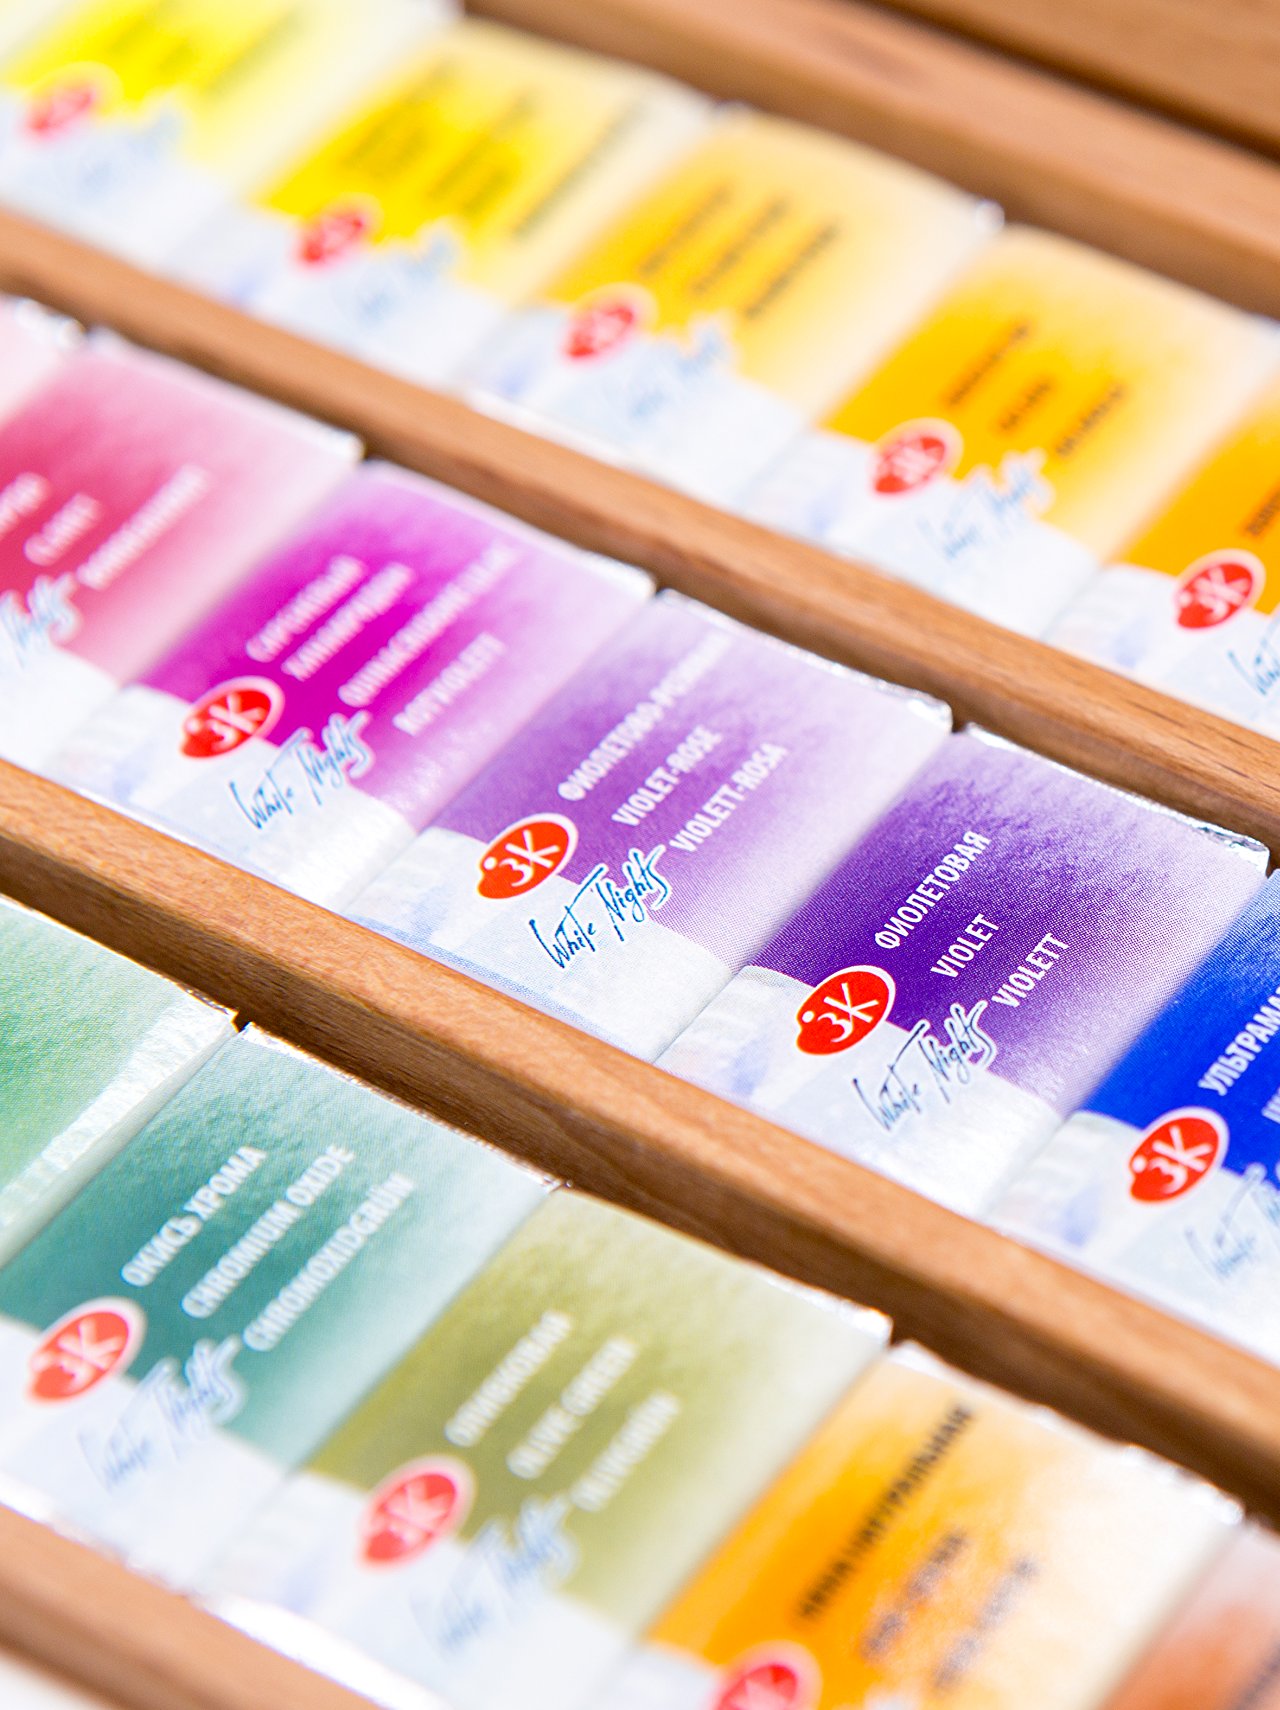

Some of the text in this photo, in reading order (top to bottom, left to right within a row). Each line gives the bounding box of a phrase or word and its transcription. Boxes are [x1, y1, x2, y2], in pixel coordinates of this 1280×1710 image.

[611, 725, 722, 826] VIOLET-ROSE
[669, 741, 789, 853] VIOLETT-ROSA
[874, 830, 992, 950] ФИОЛЕТОВАЯ
[930, 913, 1001, 978] VIOLET
[991, 931, 1069, 1008] VIOLETT
[121, 1146, 268, 1287] ОКИСЬ ХРОМА
[181, 1143, 357, 1318] CHROMIUM OXIDE
